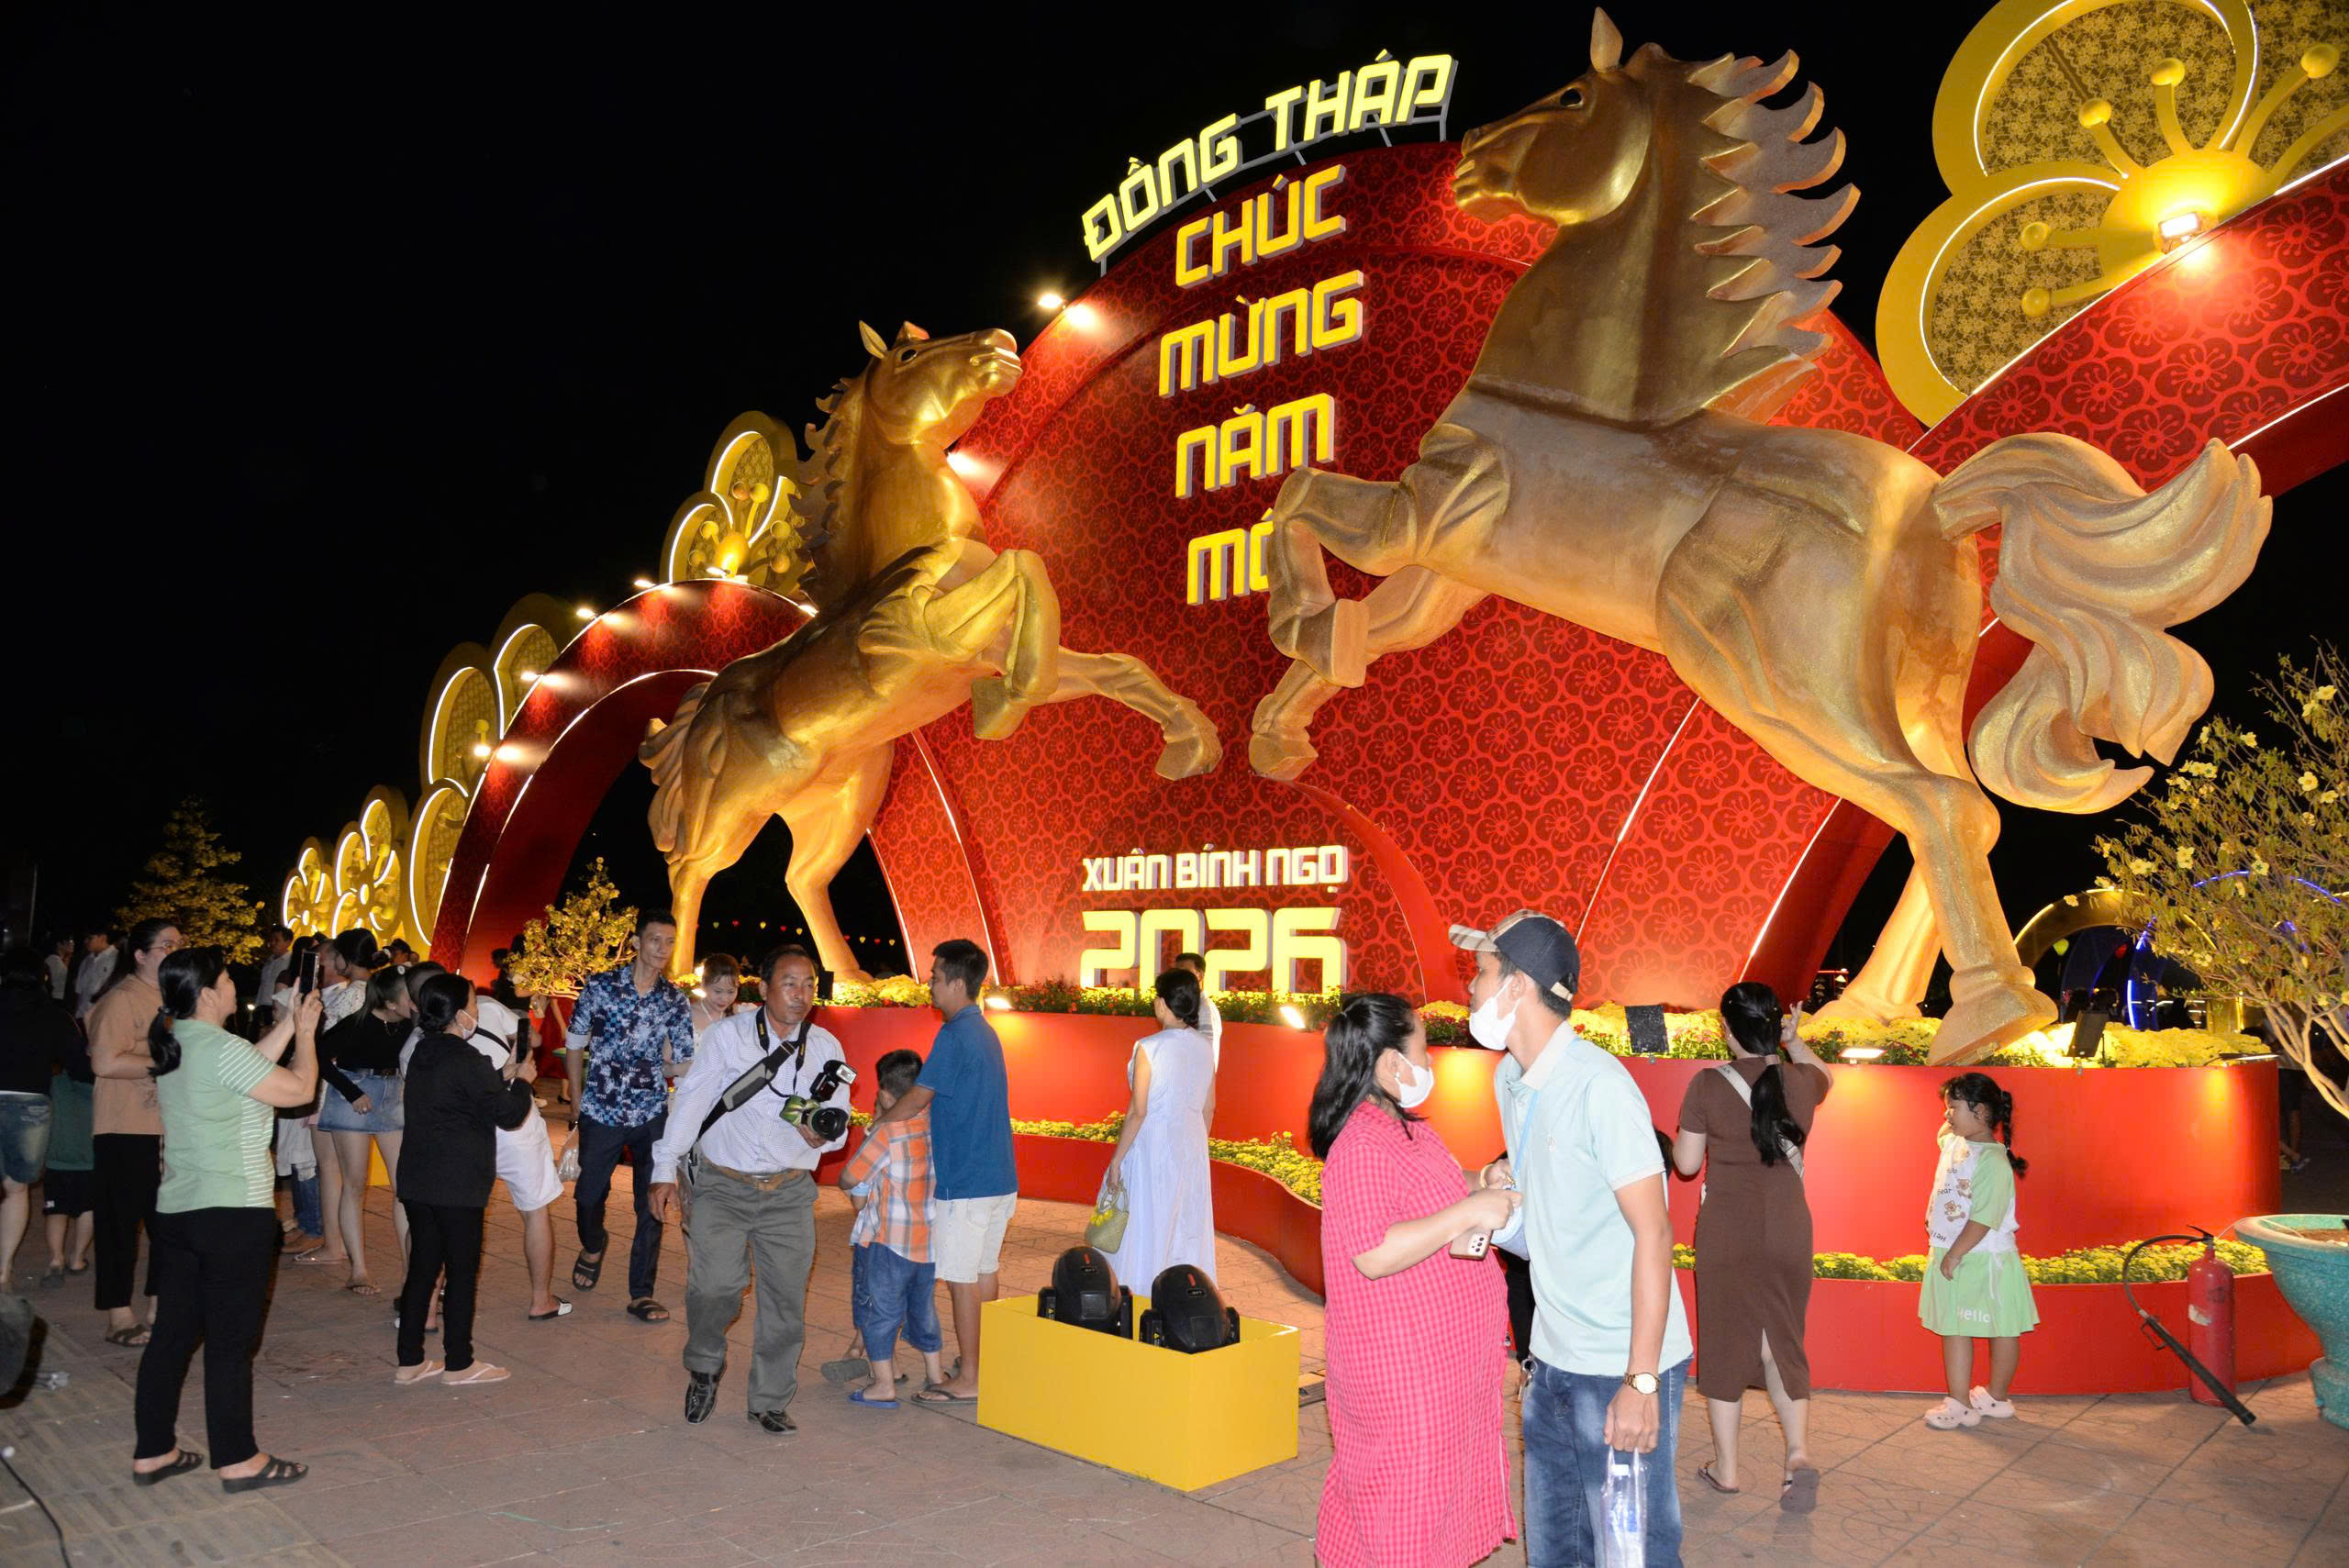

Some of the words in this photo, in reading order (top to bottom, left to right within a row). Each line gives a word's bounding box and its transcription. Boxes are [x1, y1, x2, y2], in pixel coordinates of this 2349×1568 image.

[1082, 113, 1241, 262] ĐỒNG
[1265, 49, 1456, 151] THÁP
[1175, 164, 1345, 288] CHÚC
[1159, 270, 1364, 397] MỪNG
[1175, 393, 1334, 498] NĂM
[1082, 848, 1172, 892] XUÂN
[1176, 843, 1261, 889] BÍNH
[1266, 845, 1348, 893] NGỌ
[1080, 907, 1347, 996] 2026
[1957, 1307, 1990, 1322] Hello
